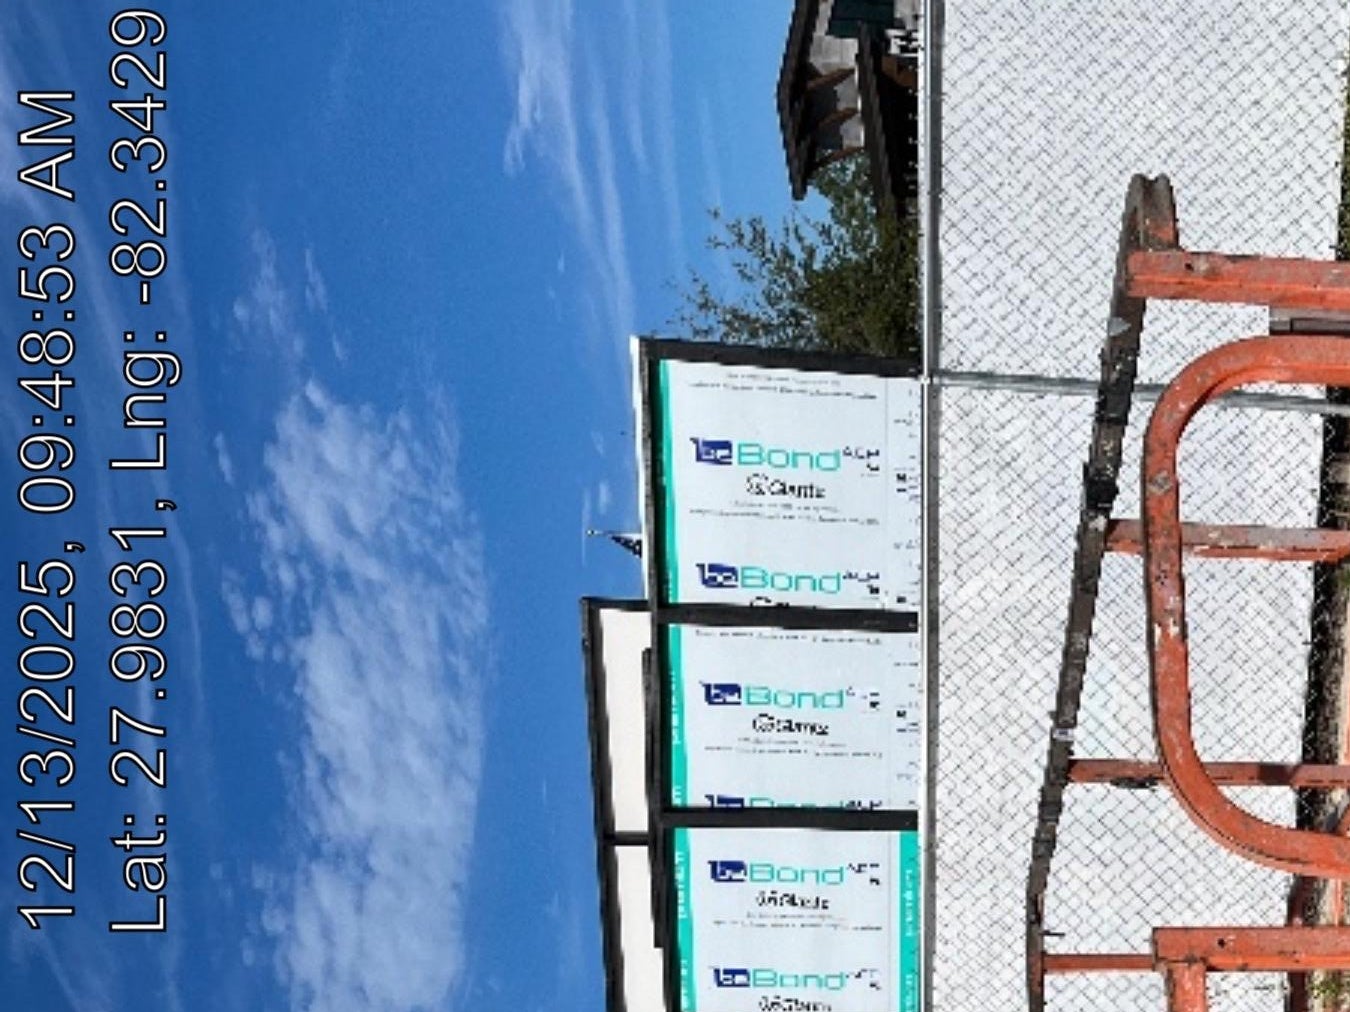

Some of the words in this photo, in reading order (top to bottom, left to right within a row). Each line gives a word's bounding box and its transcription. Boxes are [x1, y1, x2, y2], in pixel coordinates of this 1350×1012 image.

[737, 441, 841, 472] Bond
[740, 565, 841, 594] Bond
[744, 685, 845, 709] Bond
[749, 862, 845, 885] Bond
[751, 967, 846, 991] Bond
